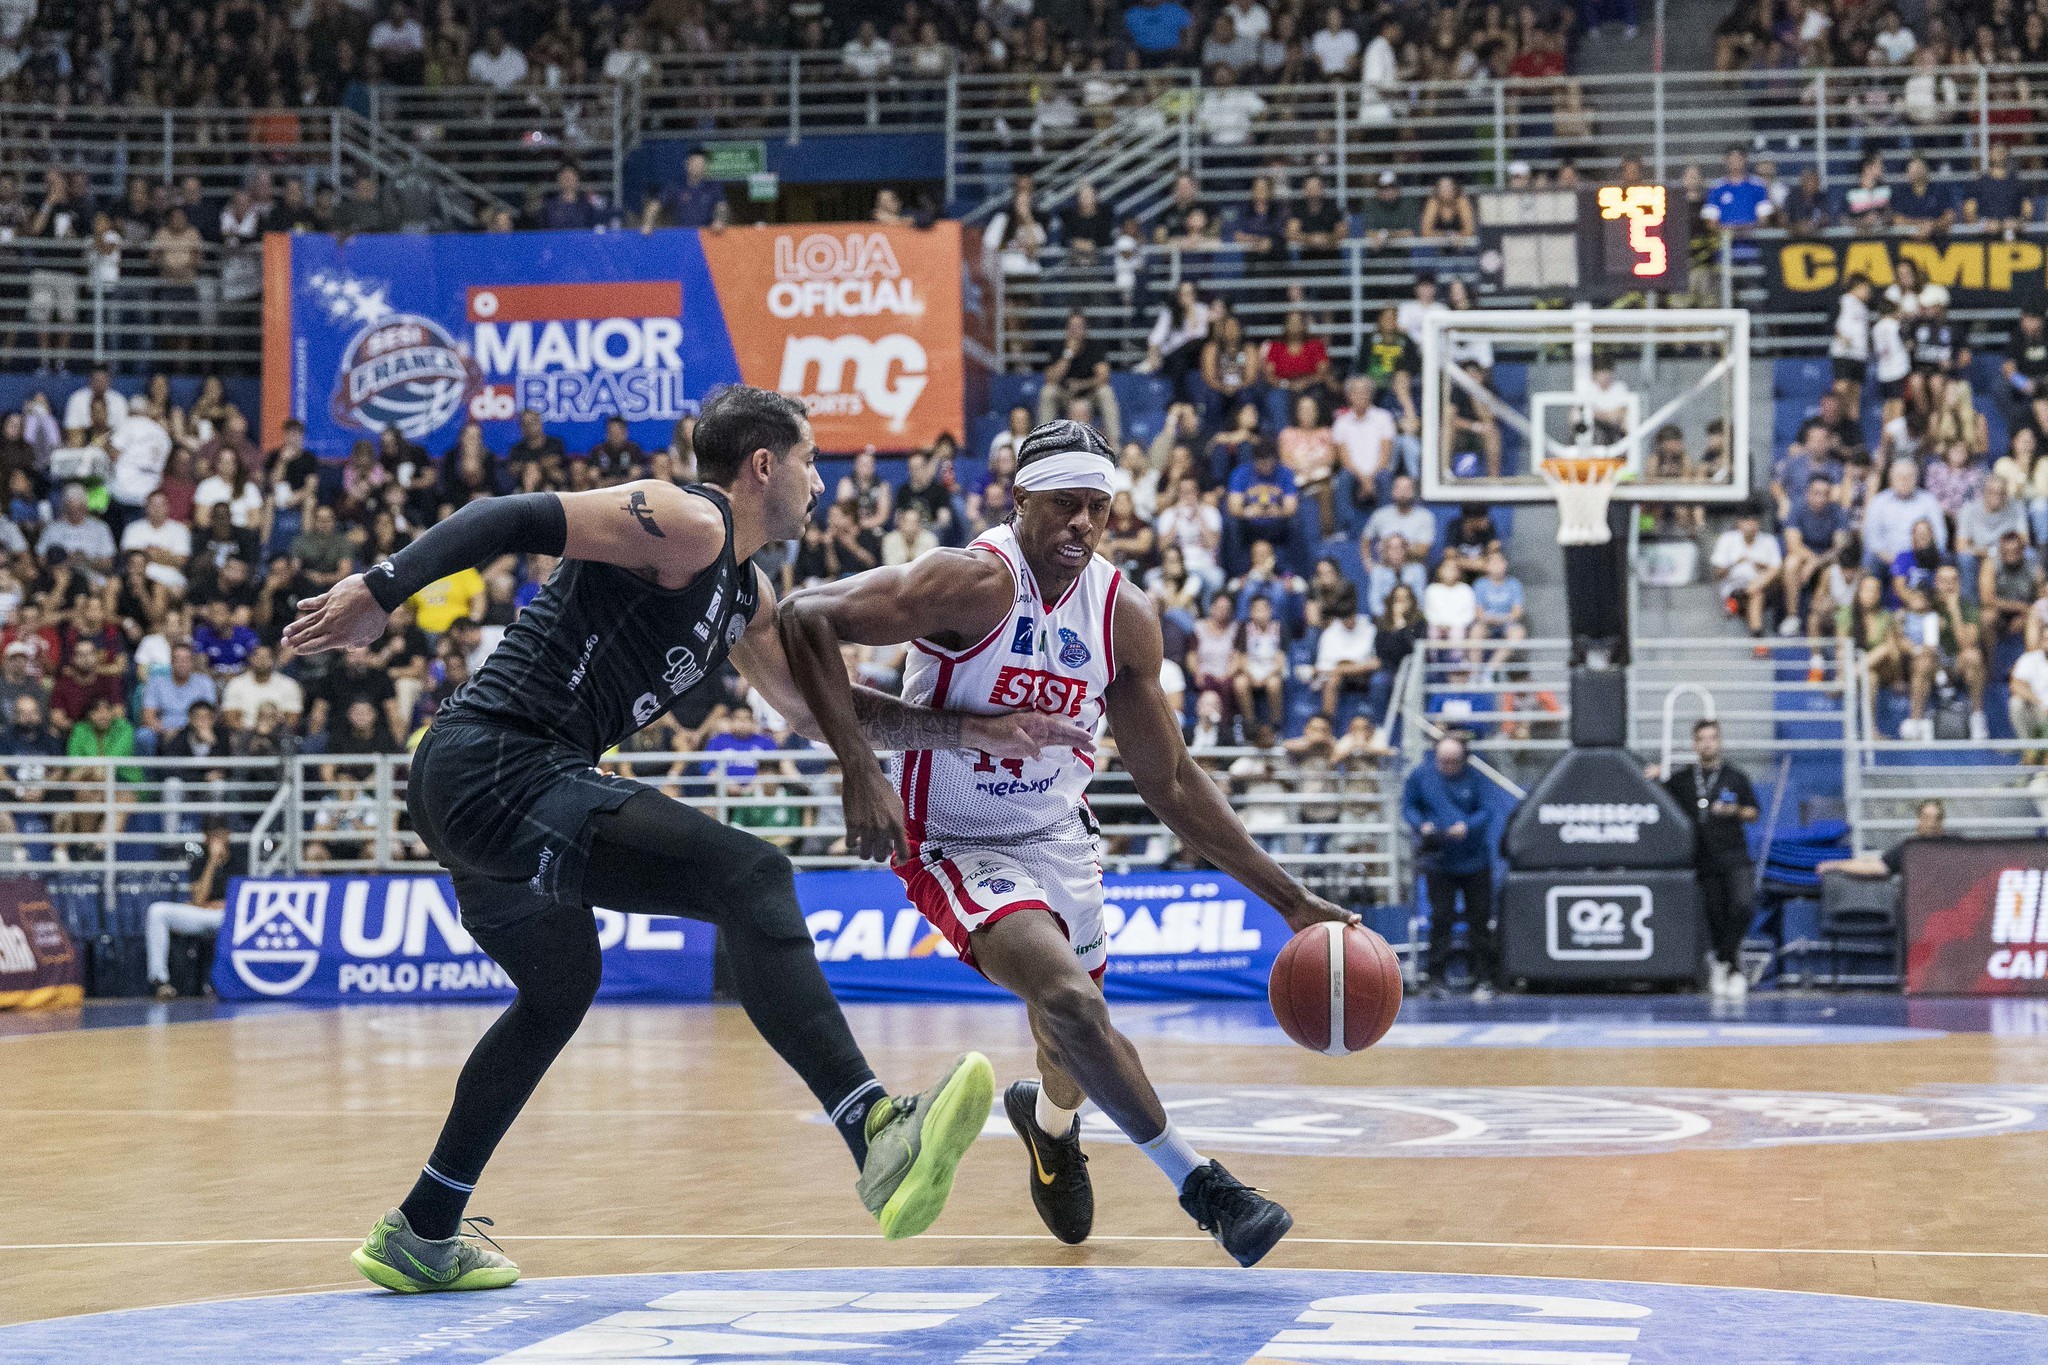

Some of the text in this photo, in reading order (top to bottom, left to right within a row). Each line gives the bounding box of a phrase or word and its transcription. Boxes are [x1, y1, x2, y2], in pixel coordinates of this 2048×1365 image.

[774, 232, 901, 281] LOJA
[1780, 240, 2048, 292] CAMP
[767, 279, 925, 318] OFICIAL
[474, 316, 683, 375] MAIOR
[469, 367, 699, 422] do BRASIL
[1559, 823, 1640, 844] ONLINE
[1568, 899, 1625, 933] Q2
[338, 960, 518, 993] POLO FRAN
[1986, 949, 2048, 980] CAI
[1244, 1292, 1654, 1365] CAI
